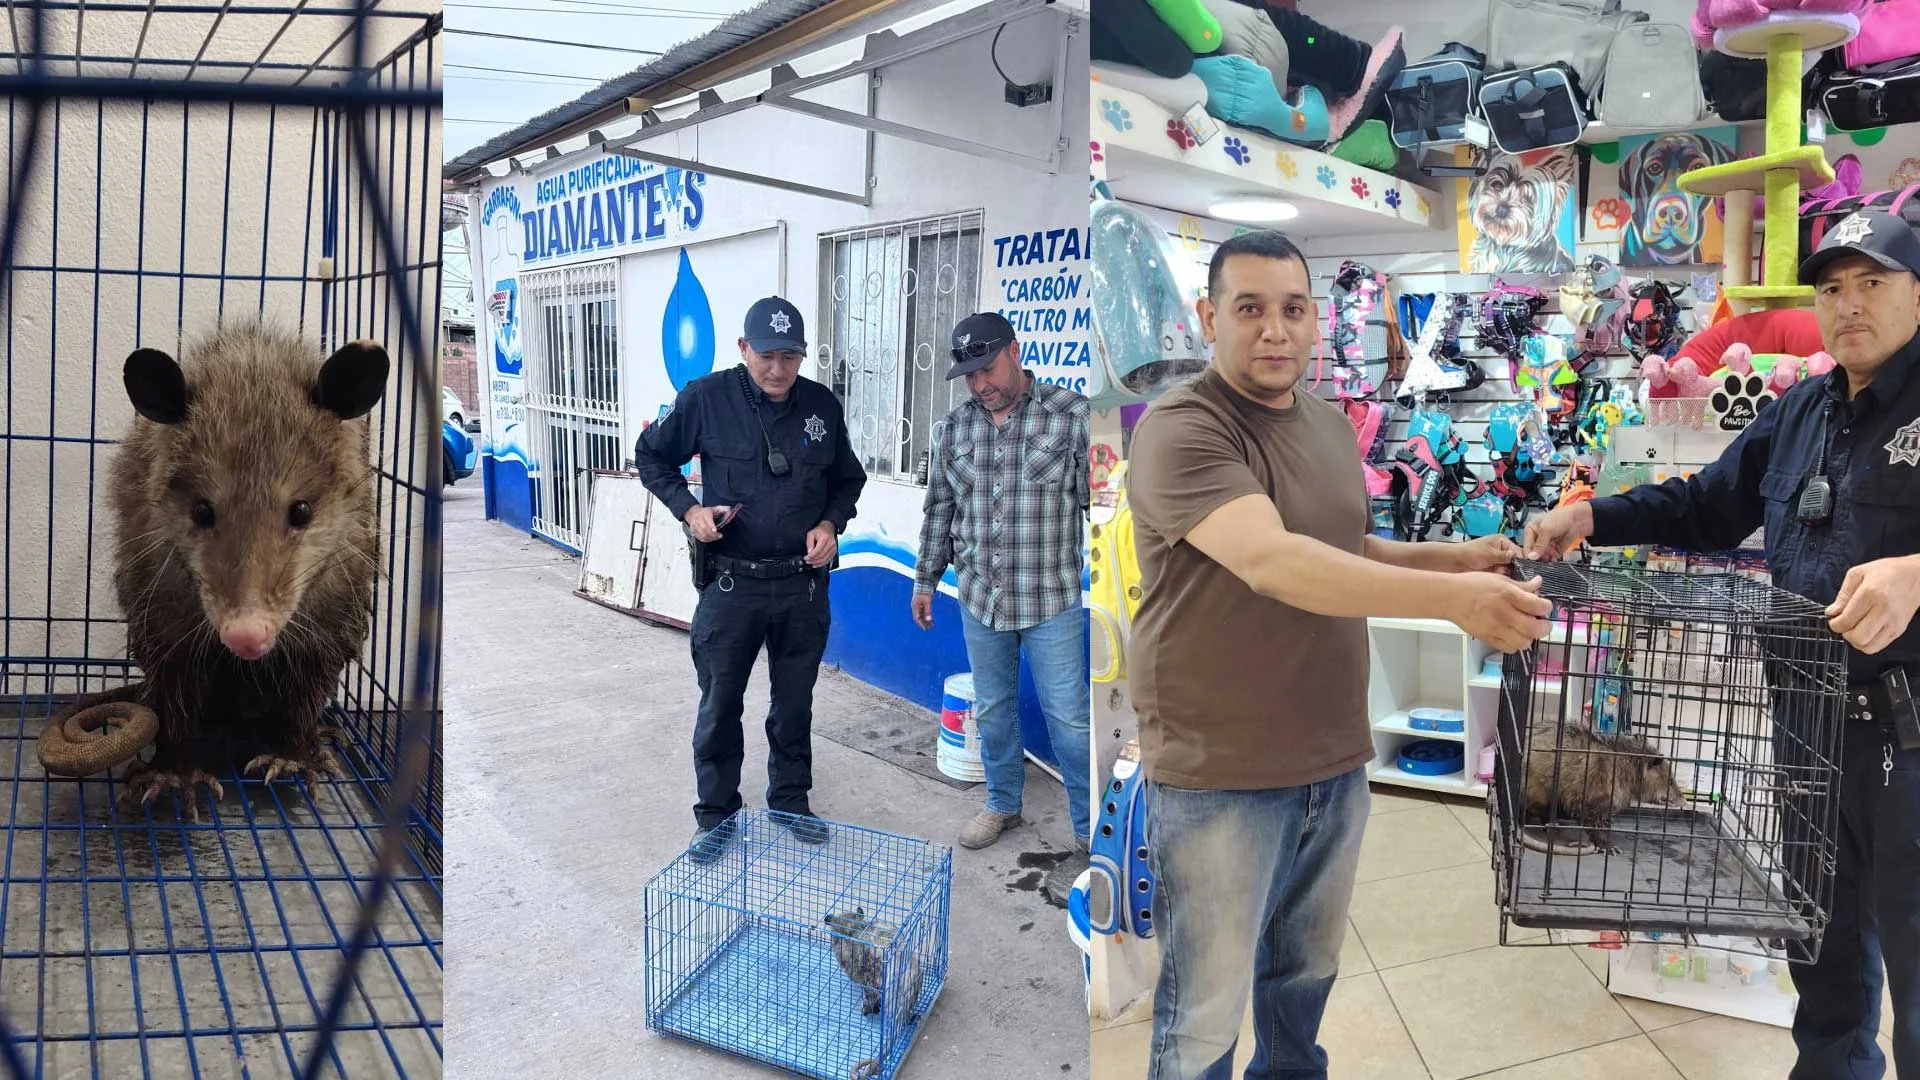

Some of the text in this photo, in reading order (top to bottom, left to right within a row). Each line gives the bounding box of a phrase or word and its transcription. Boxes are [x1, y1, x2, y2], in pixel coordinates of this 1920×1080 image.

[536, 174, 567, 206] AGUA
[1007, 307, 1066, 333] FILTRO
[1733, 404, 1751, 417] Be
[1427, 469, 1439, 485] DOG
